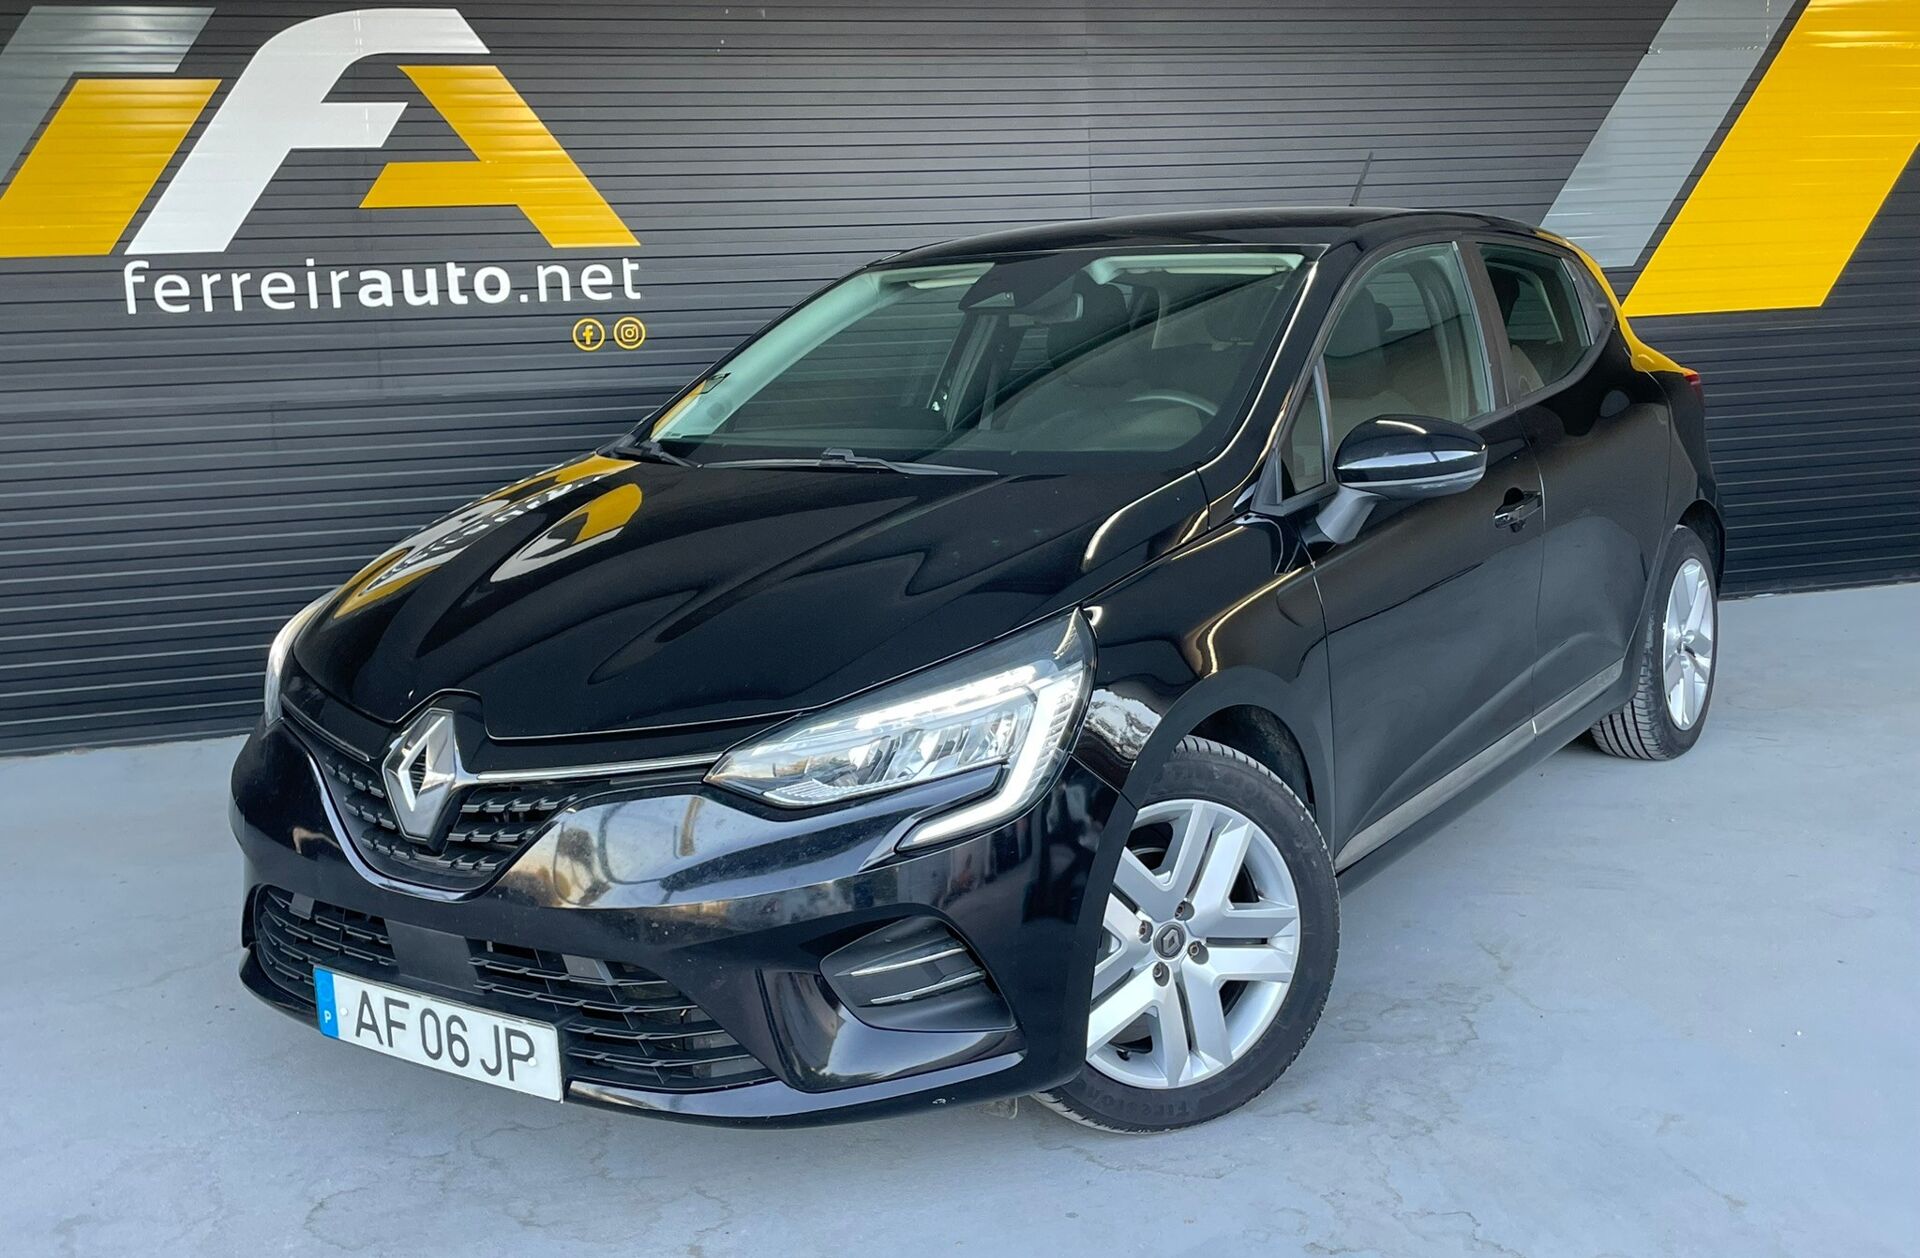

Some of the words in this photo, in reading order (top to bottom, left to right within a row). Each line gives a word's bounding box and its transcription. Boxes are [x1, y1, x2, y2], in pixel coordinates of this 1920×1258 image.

[123, 257, 642, 316] ferreirauto.net
[323, 1009, 332, 1024] P
[355, 990, 410, 1048] AF
[419, 1007, 470, 1068] 06
[480, 1024, 535, 1082] JP
